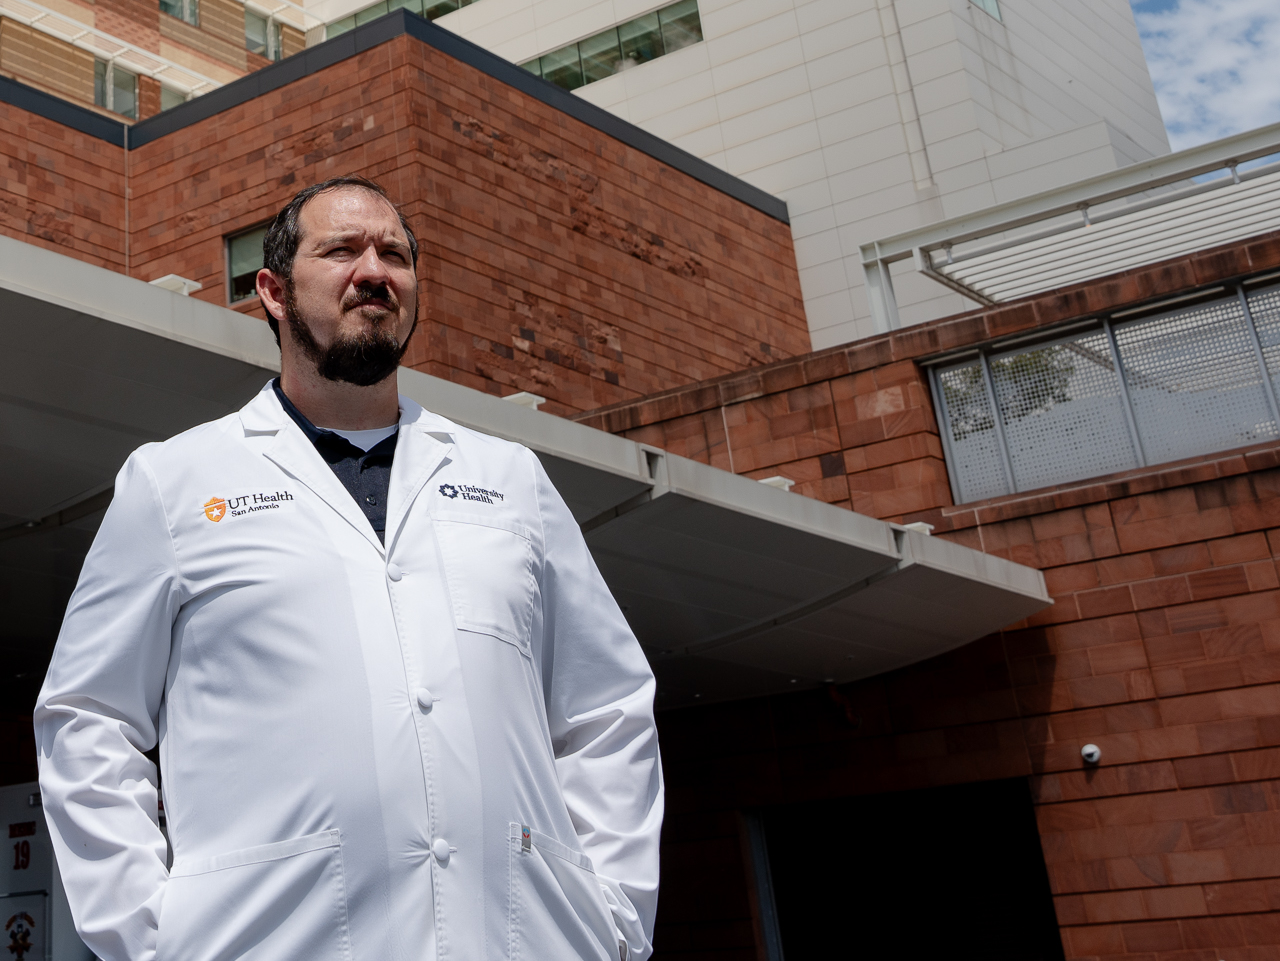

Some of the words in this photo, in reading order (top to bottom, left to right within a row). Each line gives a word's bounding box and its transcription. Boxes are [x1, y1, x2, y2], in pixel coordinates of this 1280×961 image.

[228, 495, 249, 510] UT
[252, 491, 294, 504] Health
[458, 484, 504, 501] University
[461, 492, 494, 505] Health
[248, 503, 279, 513] Antonio
[13, 840, 31, 870] 19
